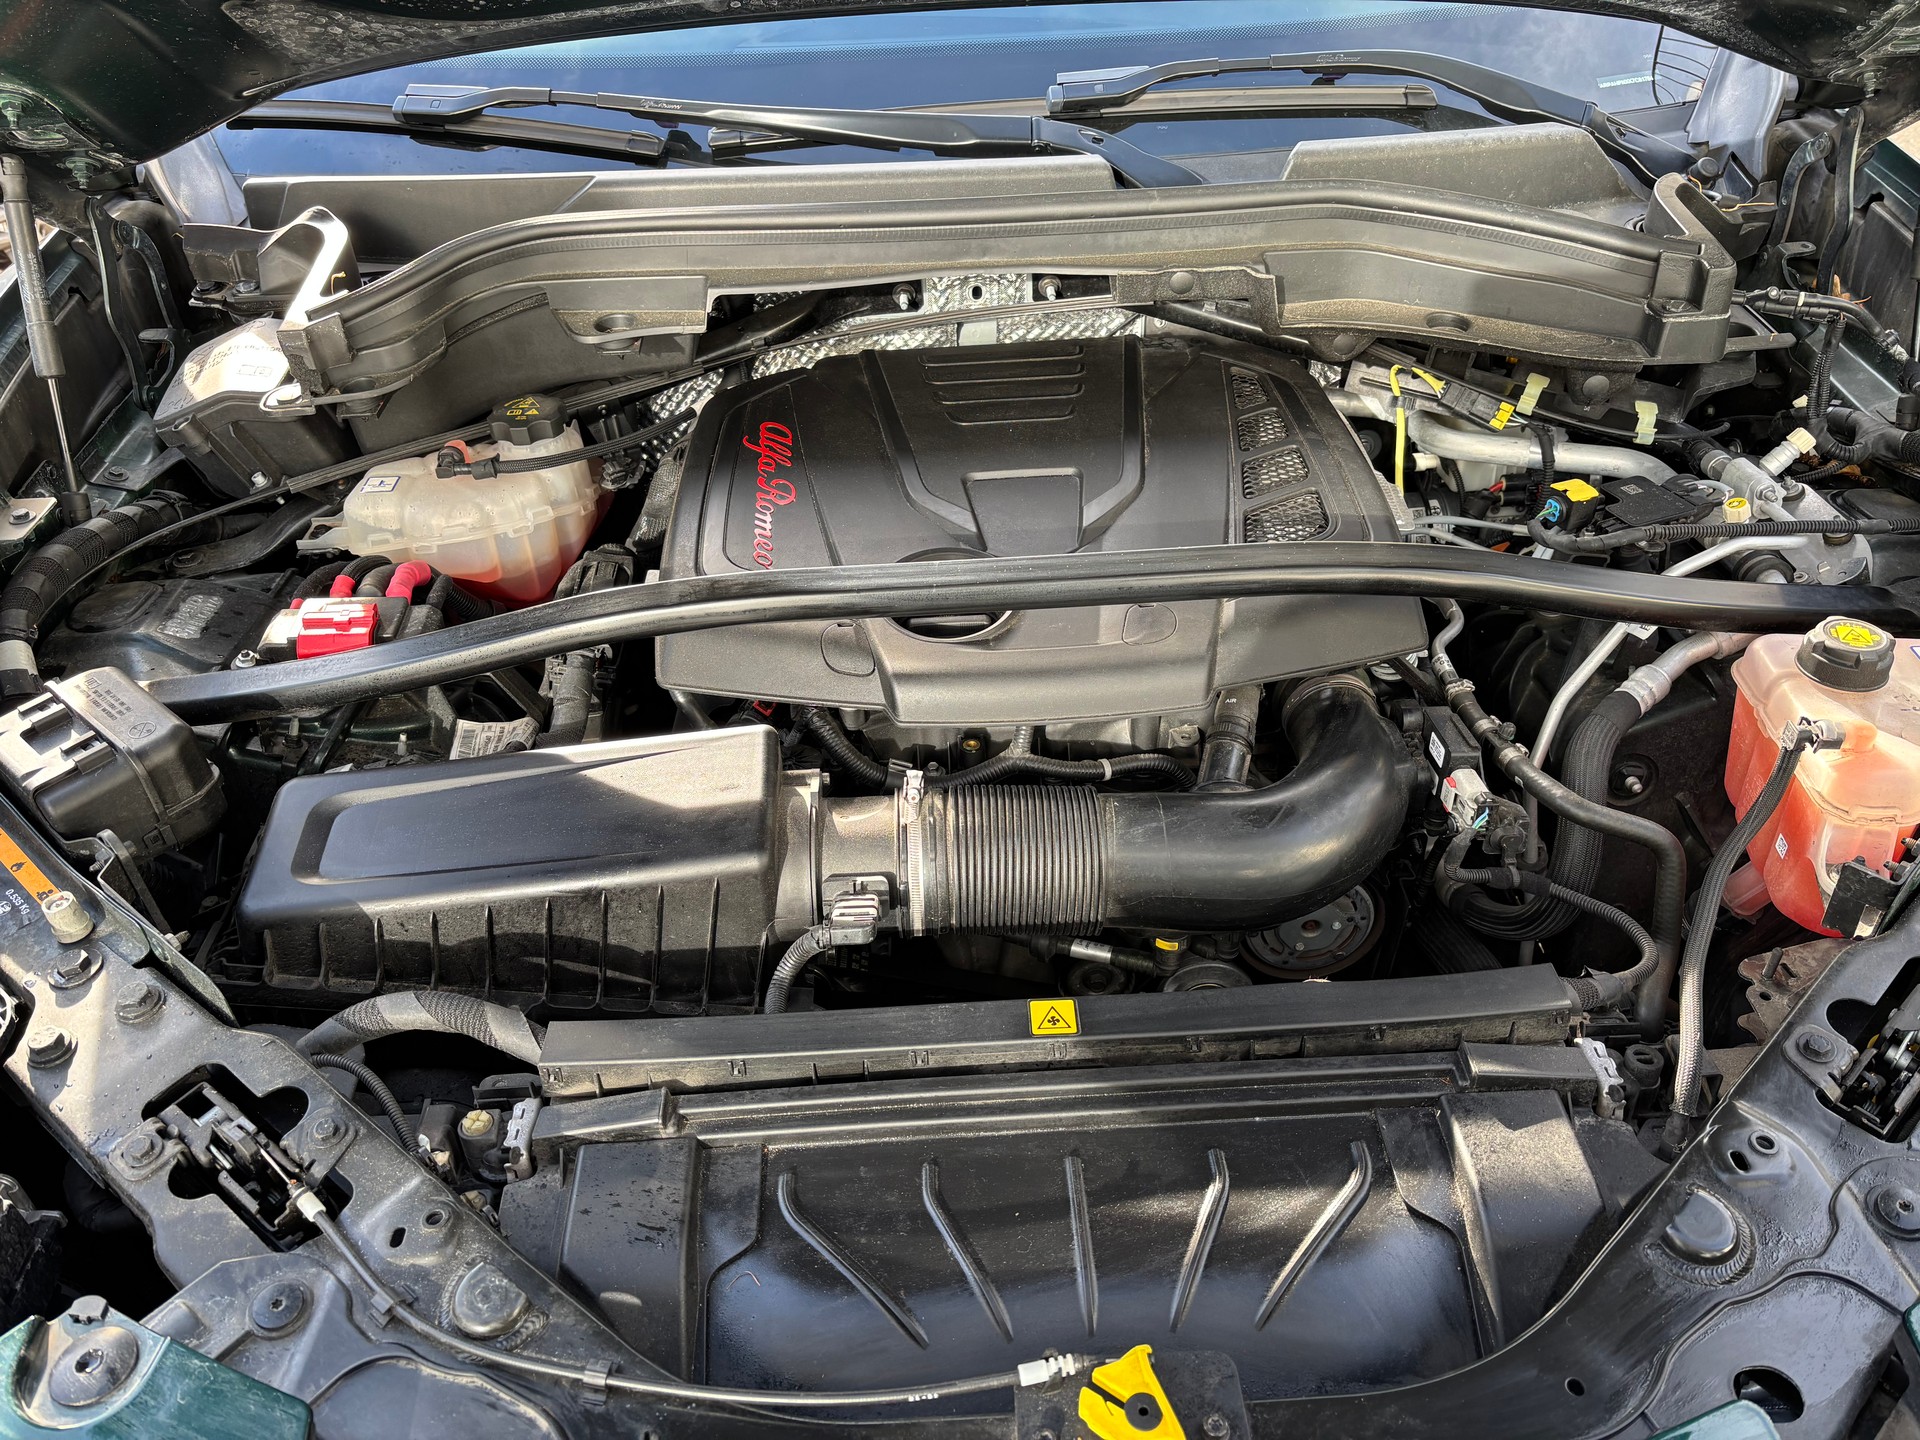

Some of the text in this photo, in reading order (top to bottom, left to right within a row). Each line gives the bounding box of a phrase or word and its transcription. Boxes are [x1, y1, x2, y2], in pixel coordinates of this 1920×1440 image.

[743, 421, 798, 569] Alfa Romeo
[5, 888, 31, 915] 0.535 Kg
